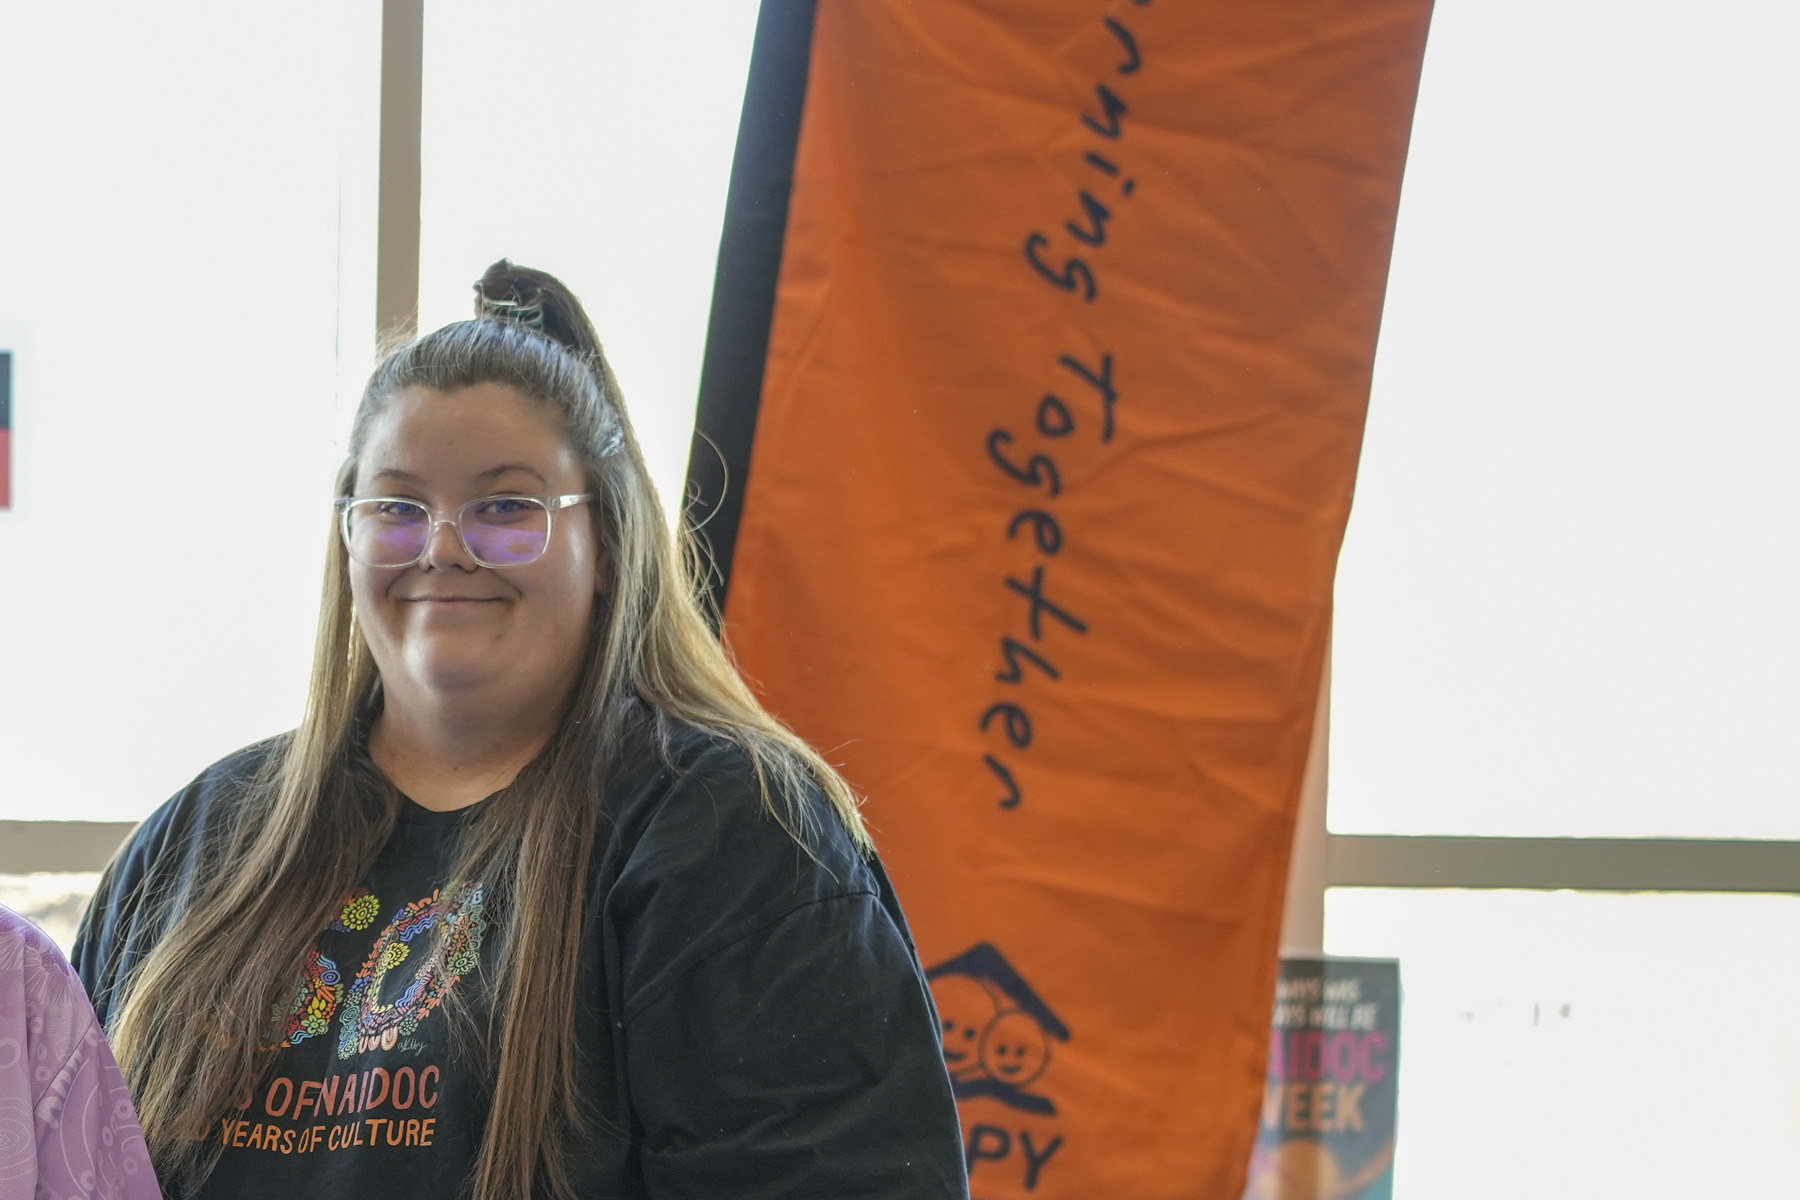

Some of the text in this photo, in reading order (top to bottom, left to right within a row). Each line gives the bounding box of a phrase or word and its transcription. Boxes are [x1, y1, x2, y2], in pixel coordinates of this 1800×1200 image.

[1022, 0, 1150, 303] rning
[979, 353, 1117, 809] Together
[221, 1118, 297, 1155] YEARS
[328, 1118, 436, 1151] CULTURE
